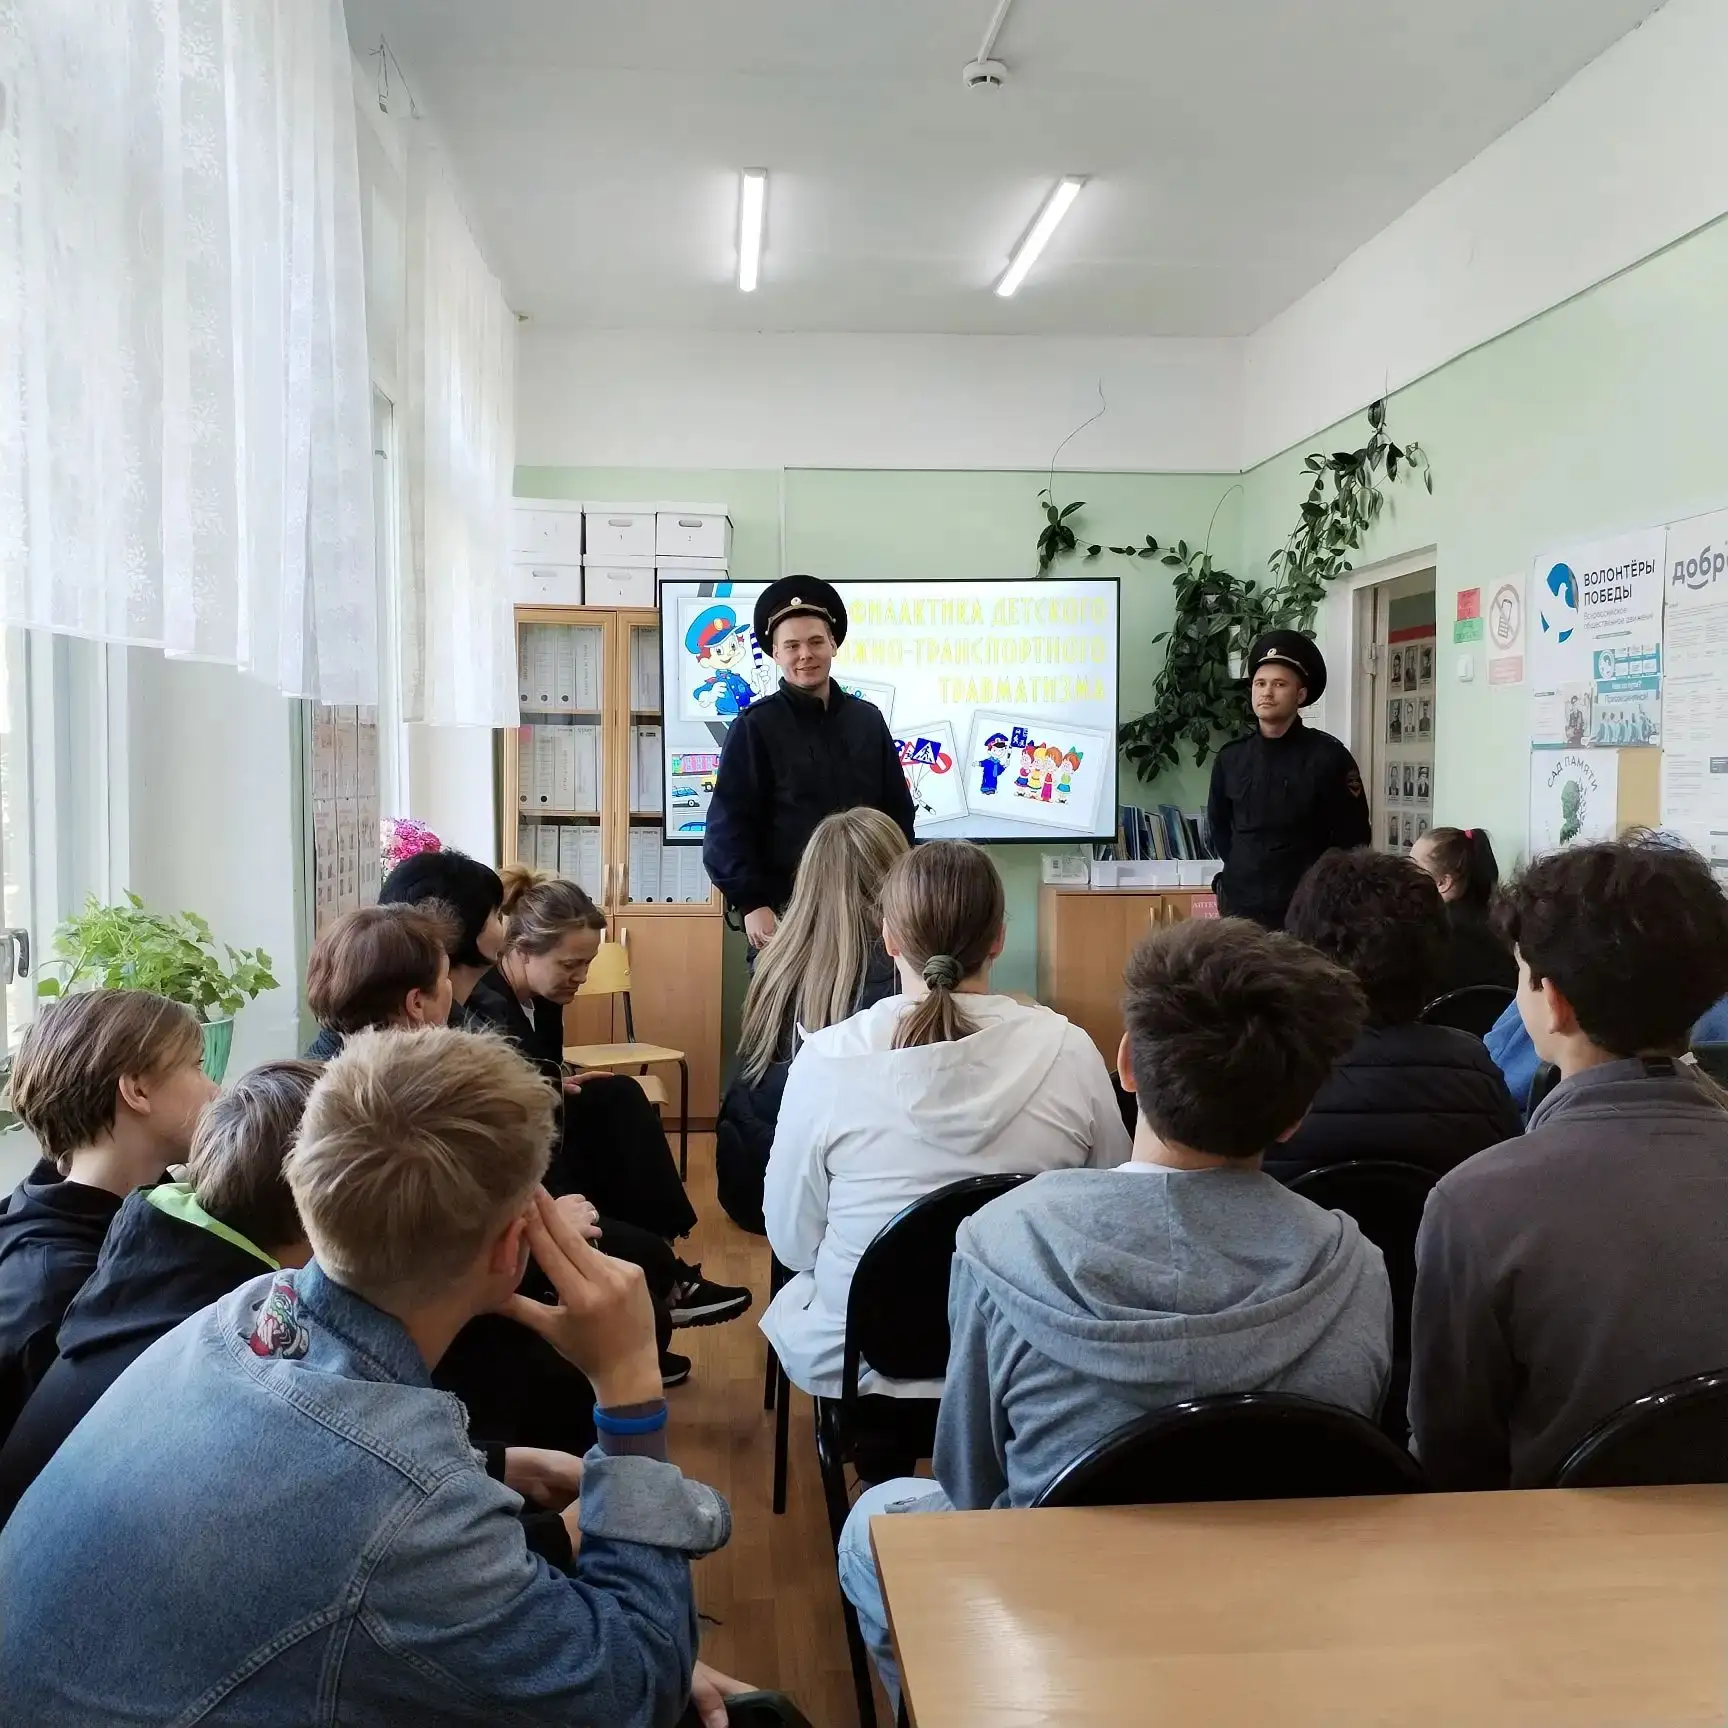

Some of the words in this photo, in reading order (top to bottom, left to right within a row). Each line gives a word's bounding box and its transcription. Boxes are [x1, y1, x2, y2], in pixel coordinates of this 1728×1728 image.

[1584, 559, 1655, 587] ВОЛОНТЁРЫ
[1672, 545, 1728, 585] добр
[1584, 584, 1632, 606] ПОБЕДЫ
[849, 598, 983, 625] ФИЛАКТИКА
[992, 596, 1107, 626] ДЕТСКОГО
[835, 634, 1105, 665] ОЖНО-ТРАНСПОРТНОГО
[938, 675, 1105, 704] ТРАВМАТИЗМА
[1547, 762, 1563, 788] САД
